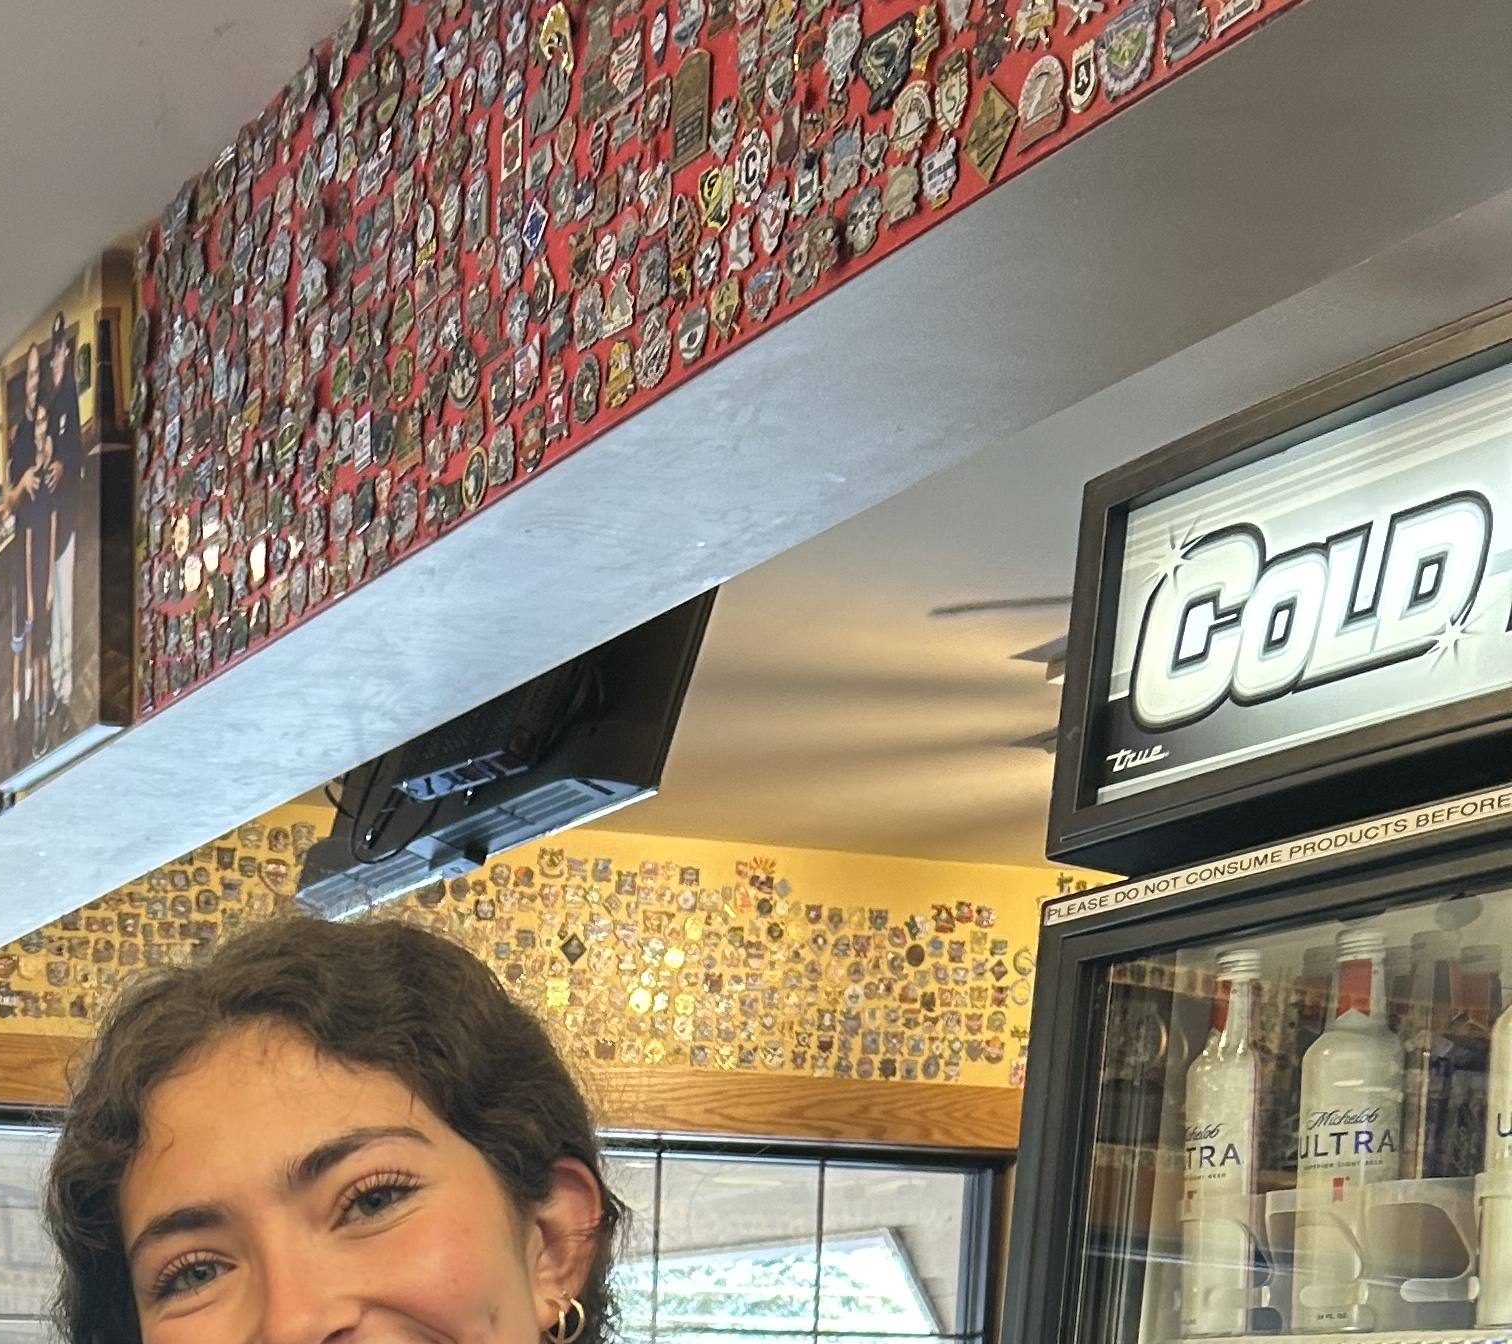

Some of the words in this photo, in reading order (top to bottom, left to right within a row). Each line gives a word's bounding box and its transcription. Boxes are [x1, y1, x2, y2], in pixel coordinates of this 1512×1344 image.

[1047, 895, 1109, 920] PLEASE
[1115, 887, 1139, 904] DO
[1144, 875, 1181, 896] NOT
[1186, 849, 1283, 885] CONSUME
[1290, 819, 1408, 860] PRODUCTS
[1416, 794, 1512, 829] BEFORE
[1307, 1107, 1382, 1130] Michelob
[1185, 1143, 1243, 1170] TRA
[1298, 1129, 1396, 1160] ULTRA
